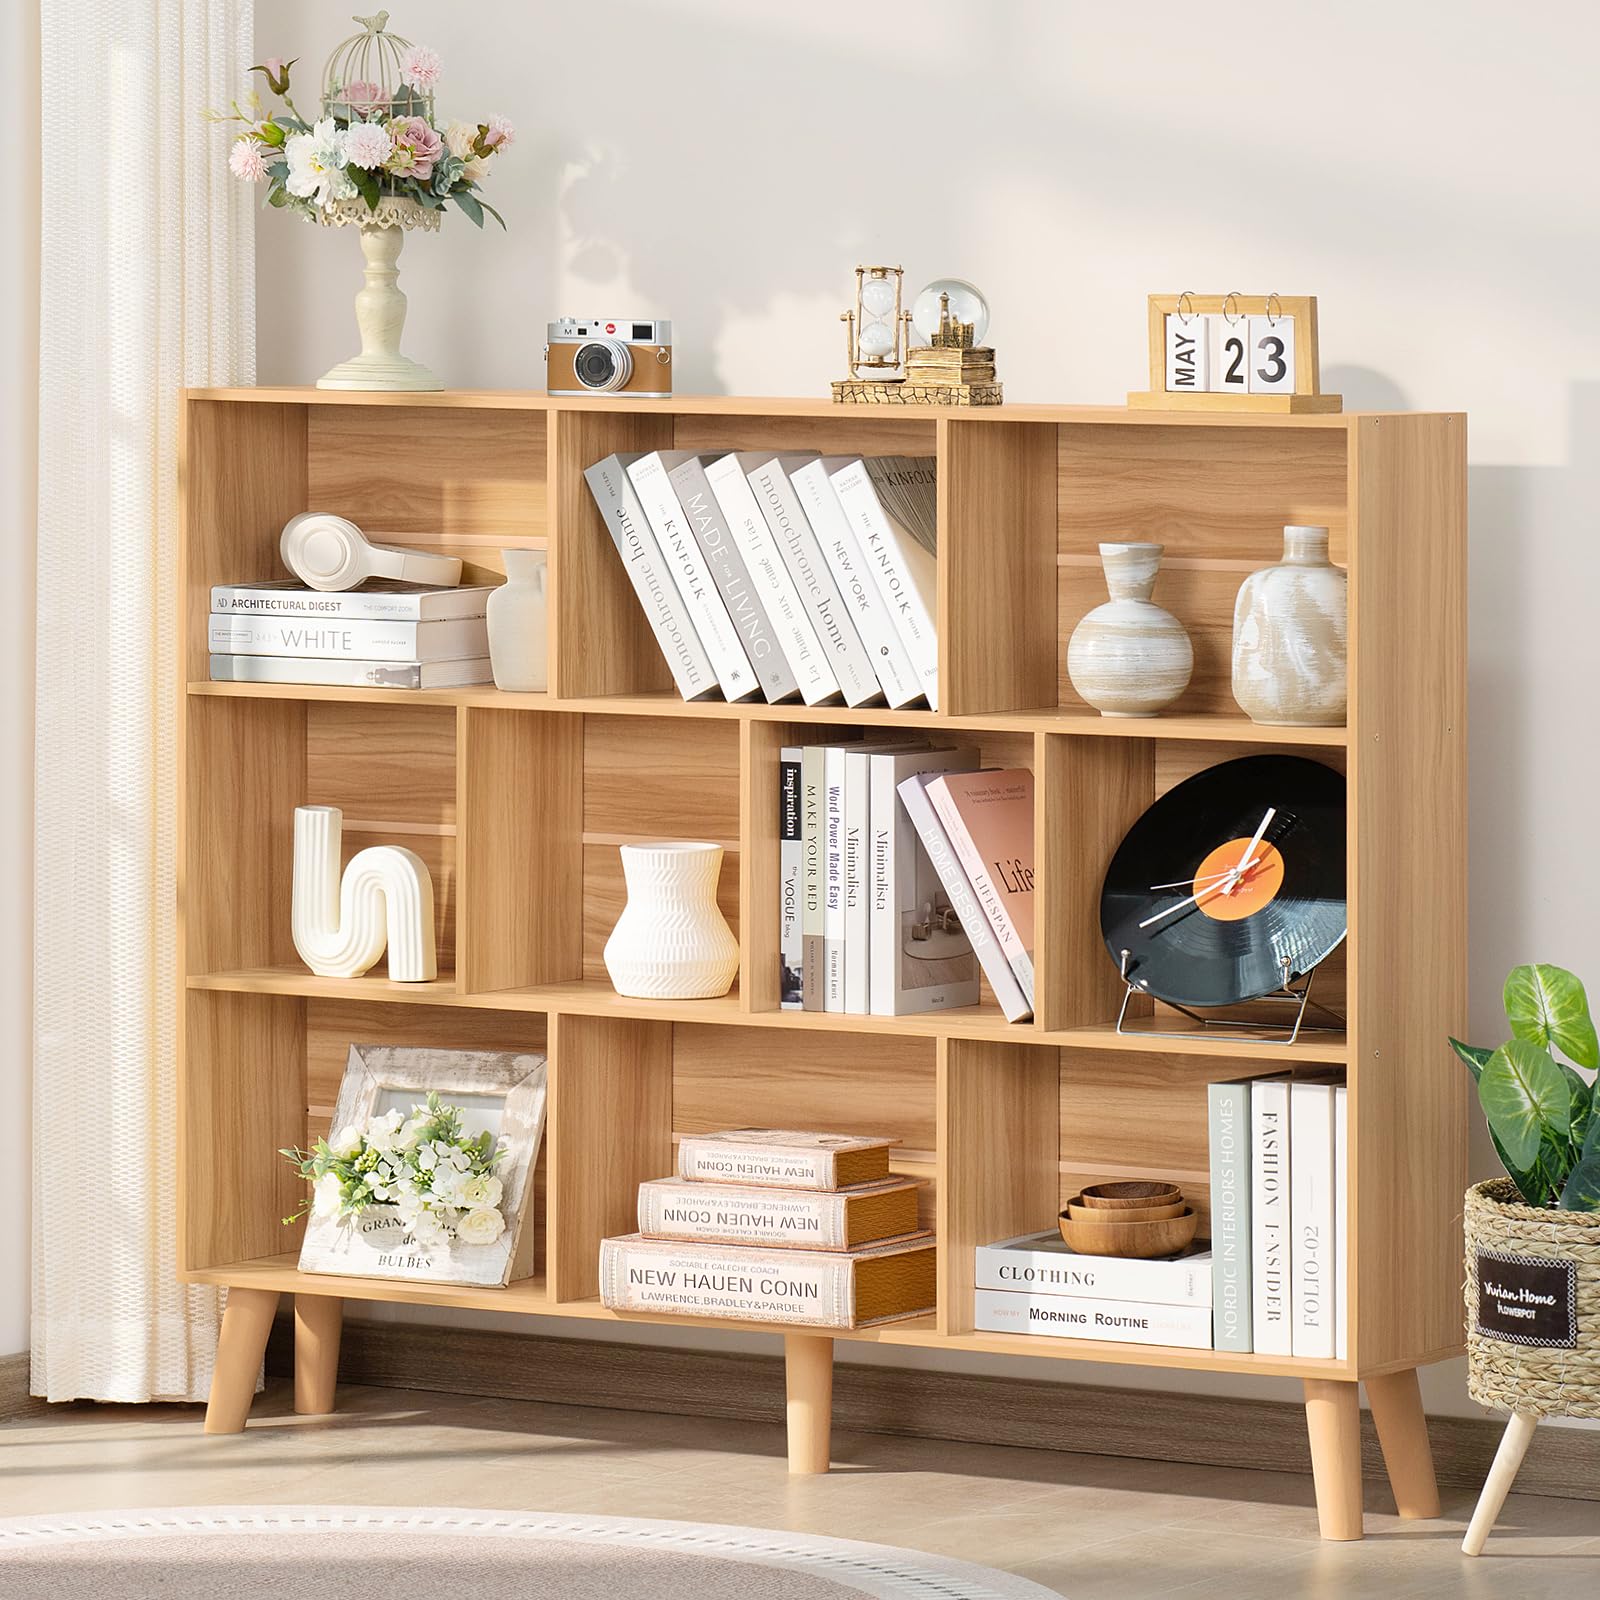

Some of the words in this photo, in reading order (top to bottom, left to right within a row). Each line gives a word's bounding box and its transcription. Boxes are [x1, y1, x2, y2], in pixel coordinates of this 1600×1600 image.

[1175, 333, 1195, 386] MAY
[1225, 337, 1244, 384] 2
[1257, 336, 1287, 384] 3
[885, 469, 937, 486] KINFOLK
[616, 507, 646, 563] home
[664, 519, 707, 601] KINFOLK
[687, 492, 729, 563] MADE
[725, 577, 772, 660] LIVING
[759, 474, 822, 597] monochrome
[817, 597, 847, 653] home
[833, 541, 854, 572] NEW
[850, 575, 871, 611] YORK
[868, 533, 911, 615] KINFOLK
[216, 598, 228, 609] AD
[231, 598, 307, 611] ARCHITECTURAL
[308, 600, 342, 612] DIGEST
[778, 594, 795, 621] aux
[640, 561, 701, 685] monochrome
[280, 629, 352, 651] WHITE
[792, 629, 811, 661] Dame
[808, 664, 821, 684] La
[784, 768, 798, 837] inspiration
[807, 785, 817, 829] MAKE
[829, 786, 840, 813] Word
[829, 816, 840, 849] Power
[807, 836, 818, 877] YOUR
[829, 852, 840, 882] Made
[848, 827, 860, 908] Minimalista
[876, 829, 889, 911] Minimalista
[923, 827, 957, 882] HOME
[949, 882, 991, 948] DESIGN
[994, 859, 1035, 893] Life
[784, 878, 795, 922] VOGUE
[807, 883, 818, 911] BED
[827, 885, 840, 910] Easy
[974, 874, 1013, 944] LIFESPAN
[1219, 1098, 1233, 1164] HOMES
[697, 1160, 733, 1172] CONN
[737, 1163, 780, 1175] HAUEN
[784, 1167, 814, 1178] NEW
[1262, 1113, 1280, 1206] FASHION
[362, 1216, 407, 1233] GRAN
[664, 1208, 711, 1223] CONN
[716, 1212, 774, 1228] HAUEN
[780, 1216, 819, 1231] NEW
[1221, 1169, 1236, 1263] INTERIORS
[378, 1255, 433, 1269] BULBES
[669, 1259, 709, 1270] SOCIABLE
[750, 1266, 780, 1276] COACH
[999, 1265, 1096, 1287] CLOTHING
[1303, 1225, 1320, 1328] FOLIO-02
[630, 1268, 676, 1287] NEW
[684, 1273, 753, 1293] HAUEN
[760, 1279, 818, 1299] CONN
[1483, 1281, 1519, 1301] Vivian
[1519, 1287, 1557, 1306] Home
[1223, 1269, 1238, 1339] NORDIC
